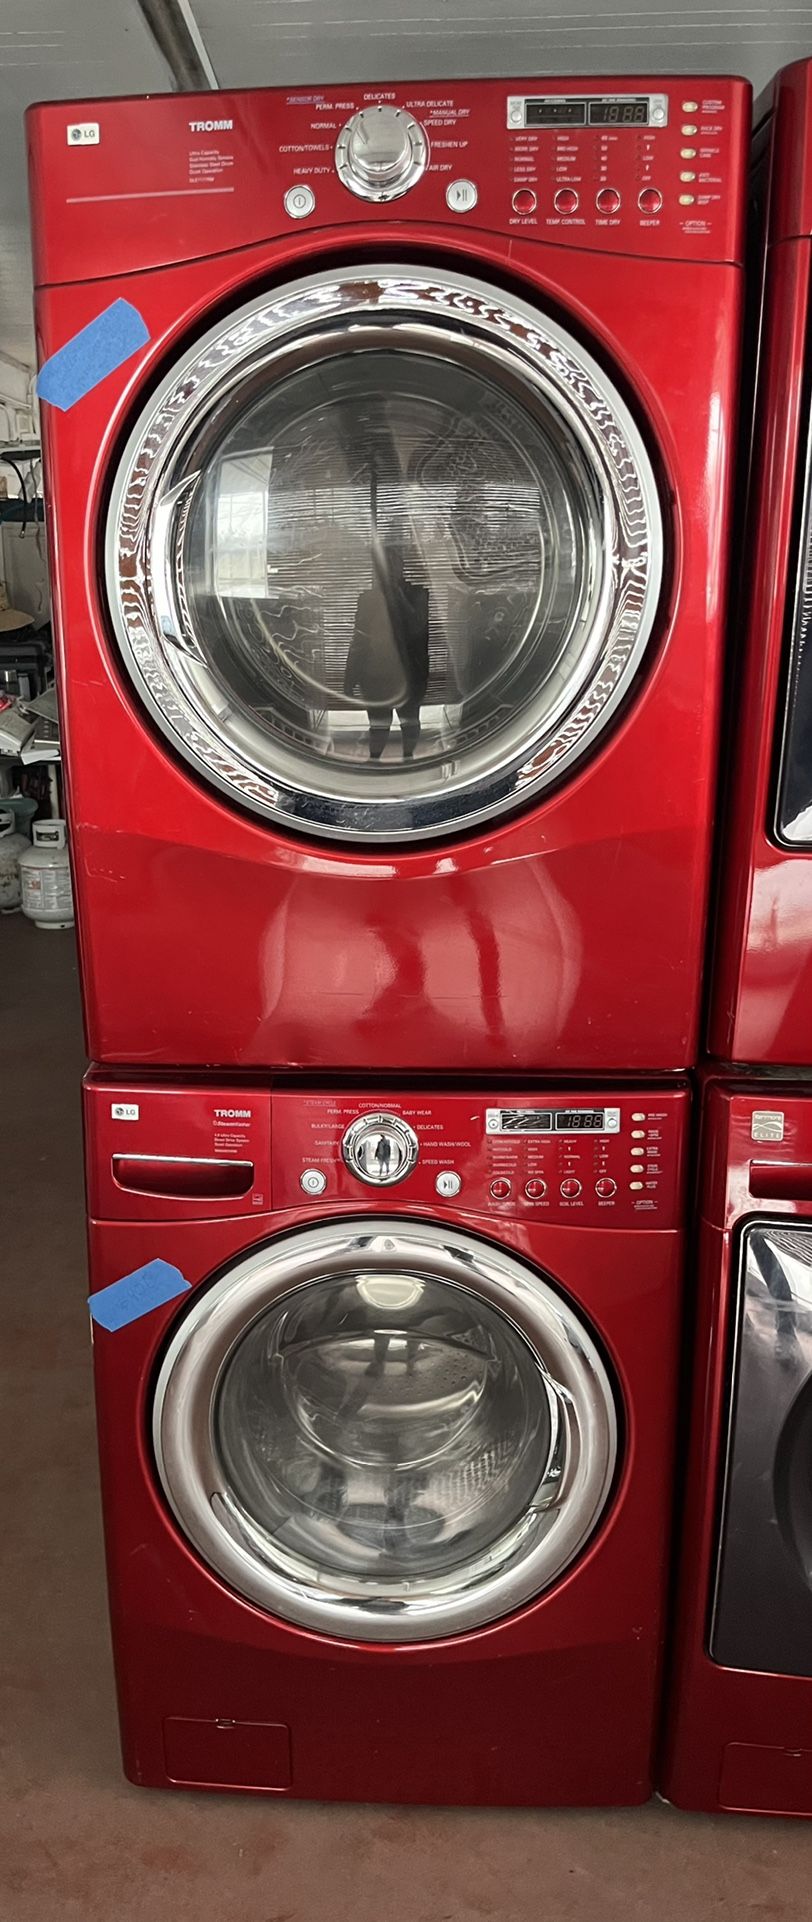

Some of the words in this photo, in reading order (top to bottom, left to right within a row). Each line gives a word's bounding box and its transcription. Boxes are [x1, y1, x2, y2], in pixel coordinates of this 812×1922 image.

[363, 93, 396, 101] DELICATES
[188, 119, 234, 132] TROMM
[84, 130, 96, 138] LG
[213, 1109, 252, 1118] TROMM
